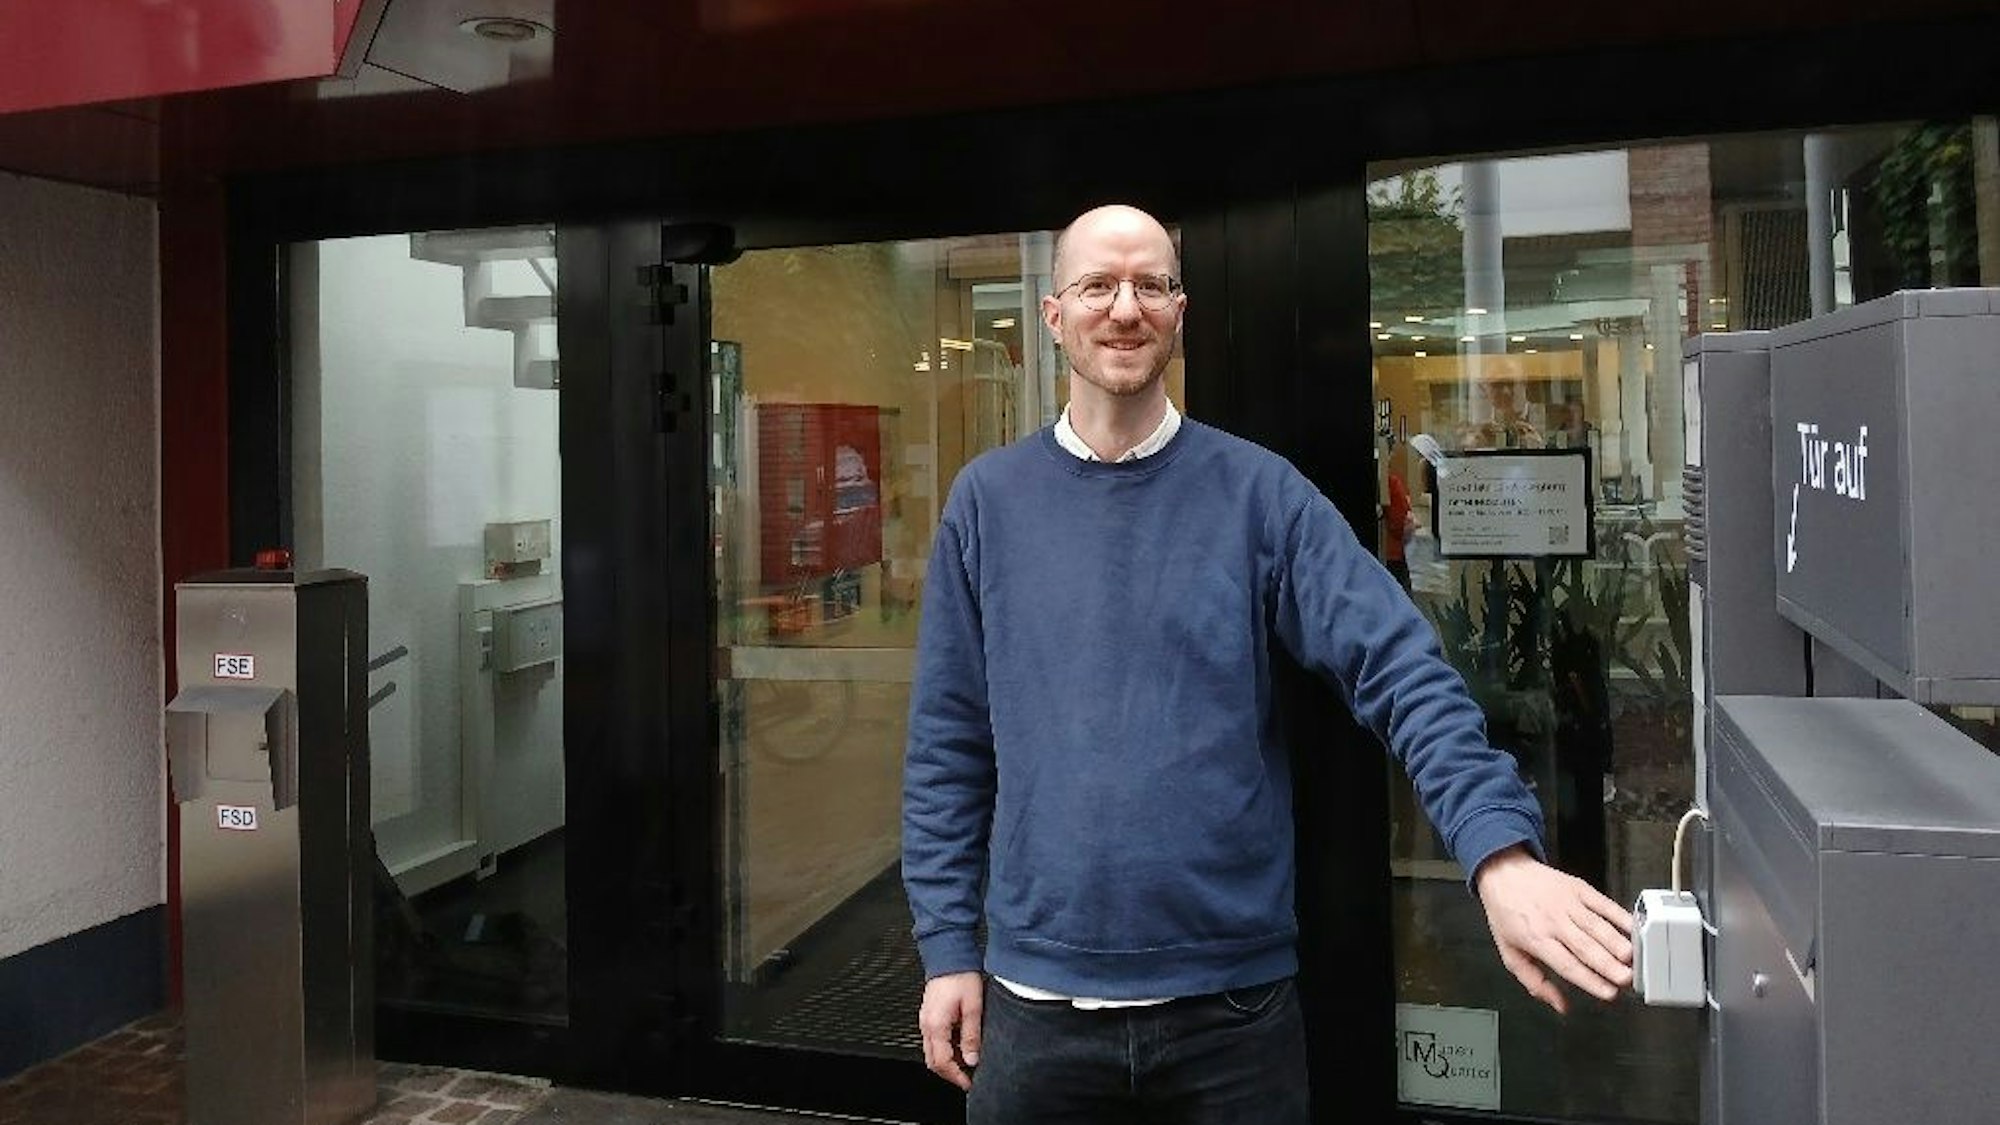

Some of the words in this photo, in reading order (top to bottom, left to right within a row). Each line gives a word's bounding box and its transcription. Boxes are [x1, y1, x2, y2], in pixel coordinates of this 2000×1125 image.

[1797, 422, 1828, 490] Tür
[1834, 425, 1868, 501] auf
[217, 657, 251, 675] FSE
[220, 809, 254, 826] FSD
[1423, 1053, 1491, 1079] Quarter
